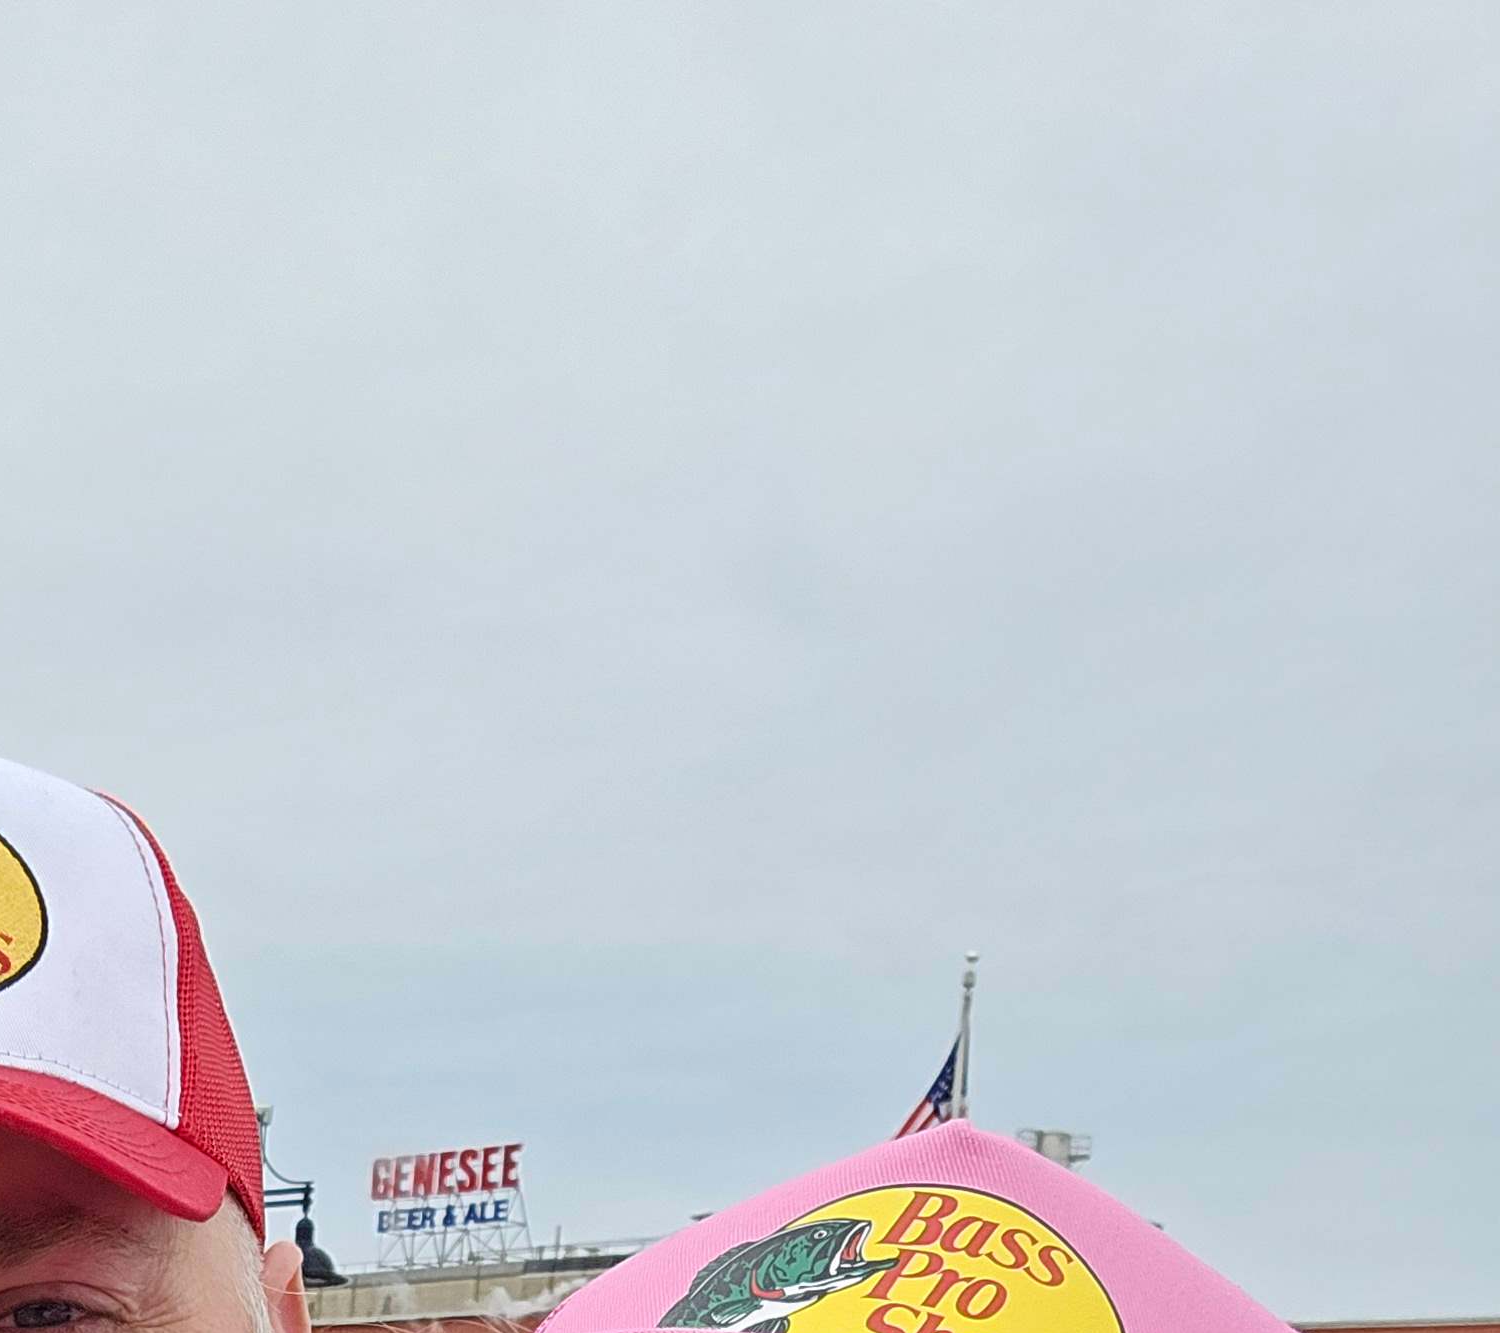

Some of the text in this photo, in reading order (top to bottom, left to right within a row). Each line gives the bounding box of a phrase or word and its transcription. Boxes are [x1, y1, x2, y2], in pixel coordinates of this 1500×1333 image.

[371, 1143, 524, 1200] GENESEE
[377, 1199, 509, 1233] BEER & ALE
[877, 1191, 1074, 1286] Bass
[861, 1248, 1008, 1320] Pro
